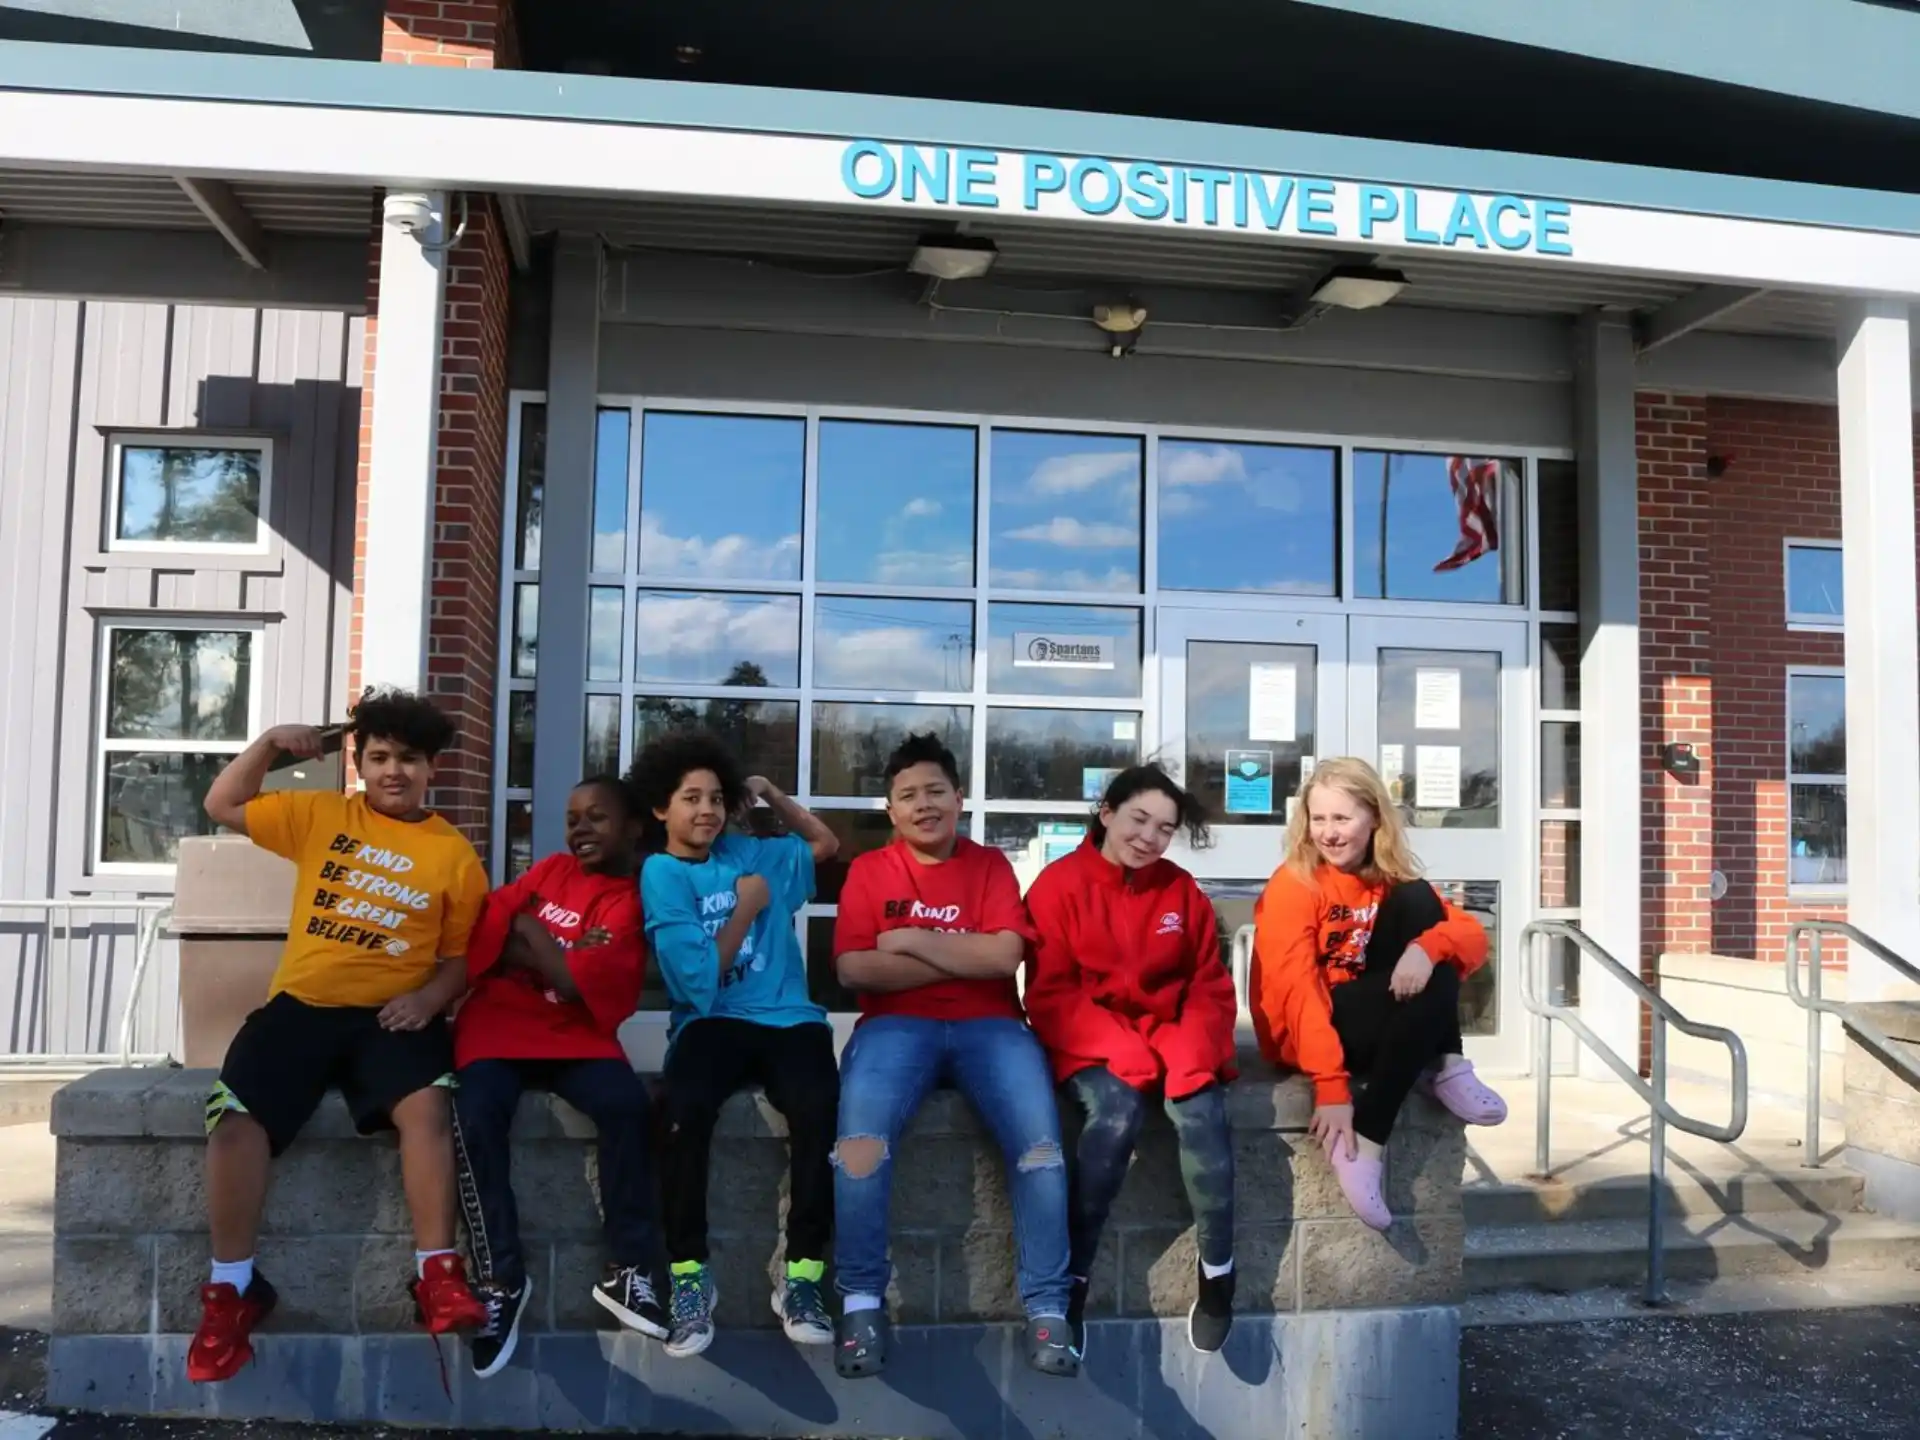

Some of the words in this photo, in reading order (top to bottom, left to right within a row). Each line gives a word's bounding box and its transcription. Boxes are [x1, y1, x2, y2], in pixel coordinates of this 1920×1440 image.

[841, 139, 999, 209] ONE
[1024, 153, 1337, 236] POSITIVE
[1359, 184, 1574, 256] PLACE
[1049, 641, 1101, 657] Spartans
[329, 833, 361, 855] BE
[355, 844, 414, 873] KIND
[319, 860, 348, 883] BE
[344, 869, 430, 909] STRONG
[312, 888, 341, 910] BE
[336, 897, 408, 929] GREAT
[910, 899, 960, 923] KIND
[305, 916, 389, 950] BELIEVE
